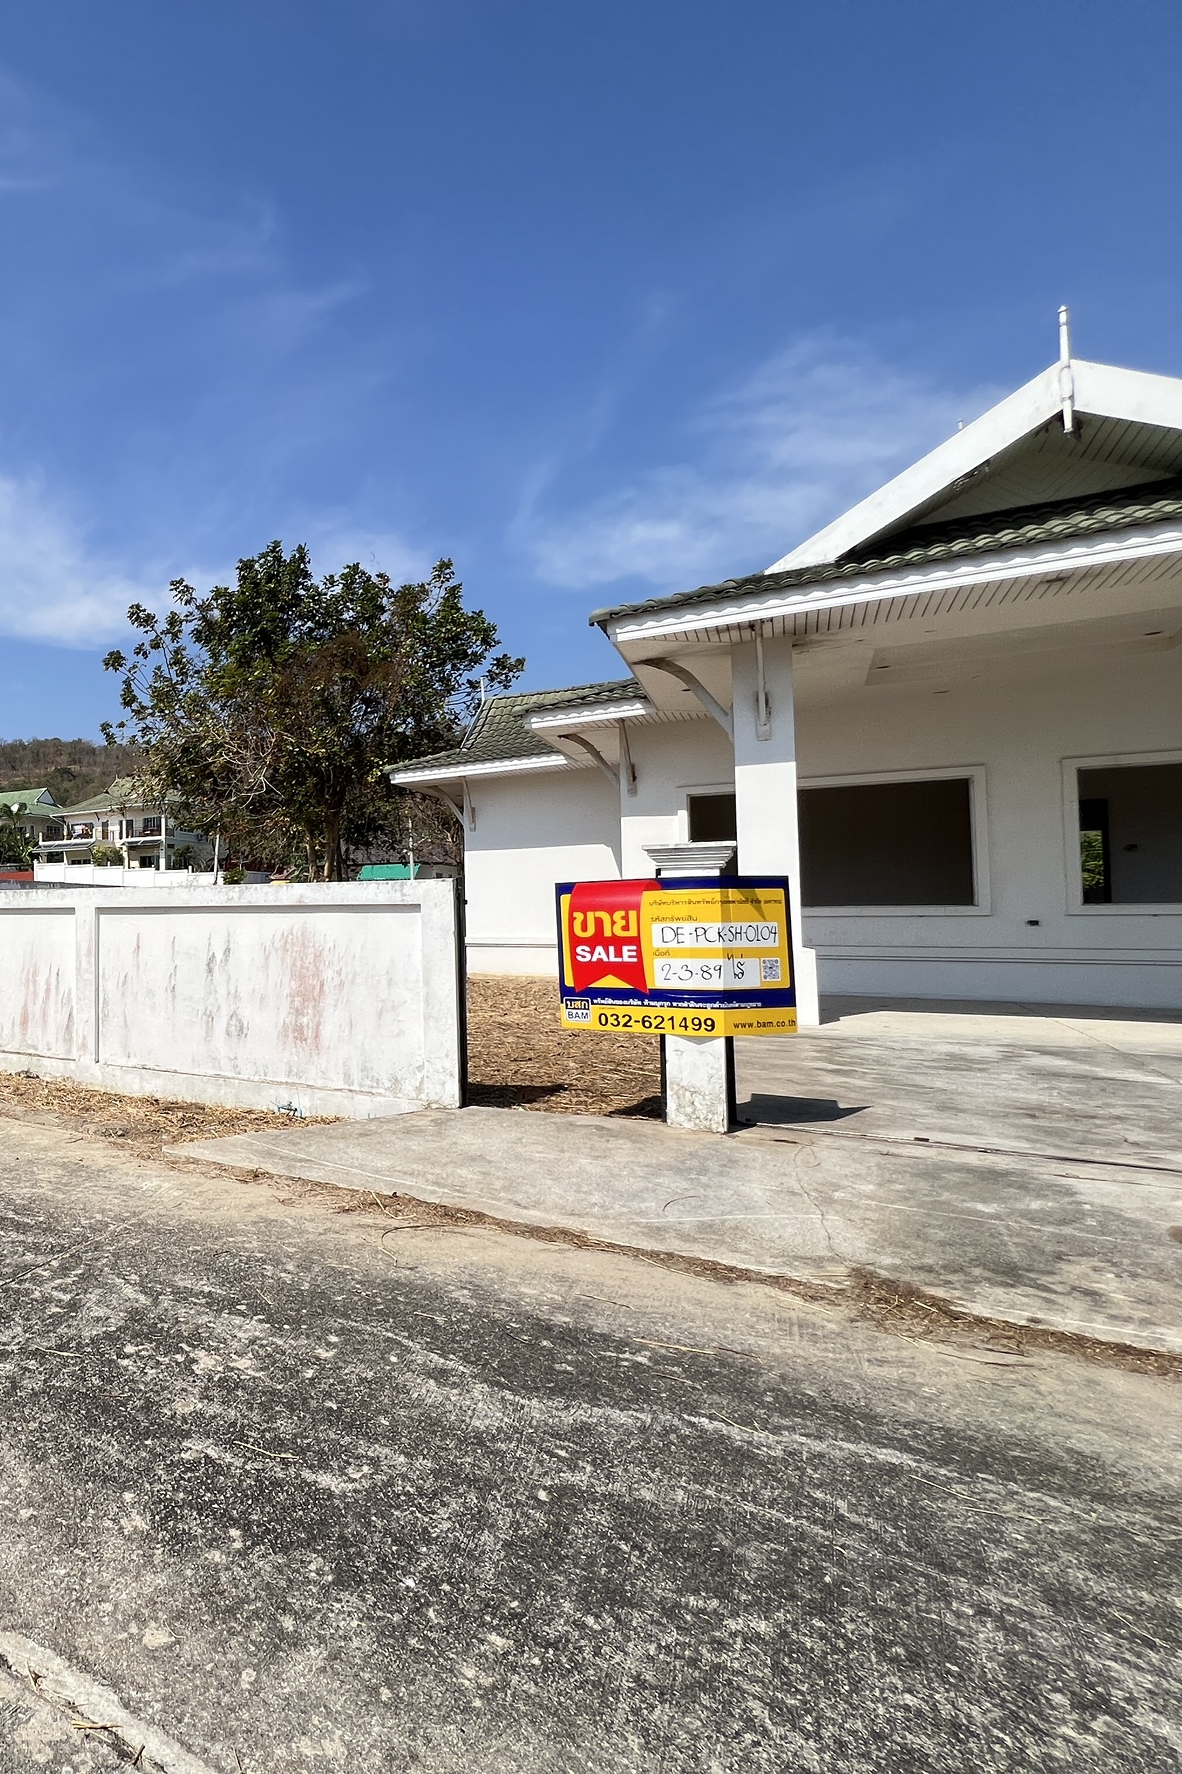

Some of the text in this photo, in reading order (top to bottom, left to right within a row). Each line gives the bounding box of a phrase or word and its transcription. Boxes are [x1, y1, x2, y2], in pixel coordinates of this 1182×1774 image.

[572, 909, 638, 938] ขาย
[575, 945, 638, 963] SALE
[661, 963, 723, 981] 2-3-89
[566, 1000, 589, 1009] บสก
[567, 1011, 589, 1020] BAM
[598, 1012, 716, 1033] 032-621499
[733, 1019, 796, 1029] www.bam.co.th
